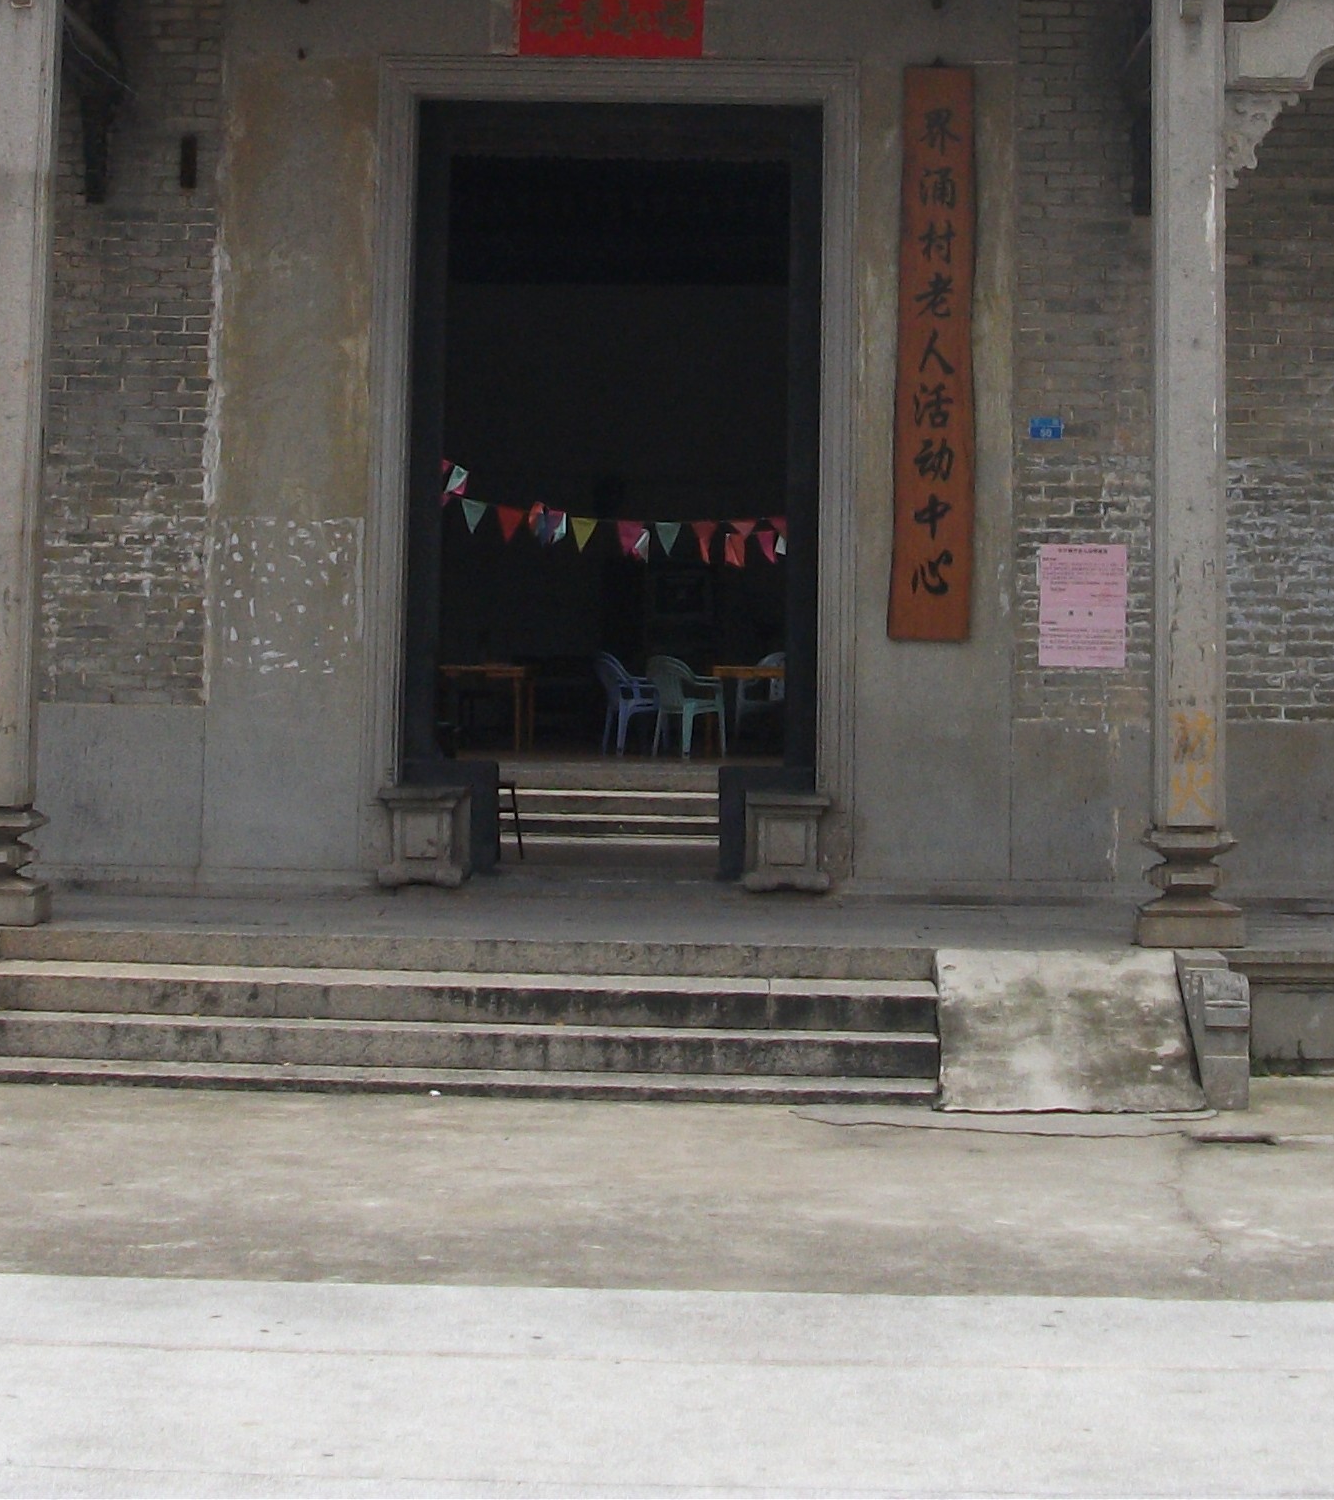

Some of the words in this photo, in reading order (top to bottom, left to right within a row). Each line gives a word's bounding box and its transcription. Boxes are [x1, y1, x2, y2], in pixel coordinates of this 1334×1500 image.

[910, 108, 963, 596] 界涌村老人活动中心
